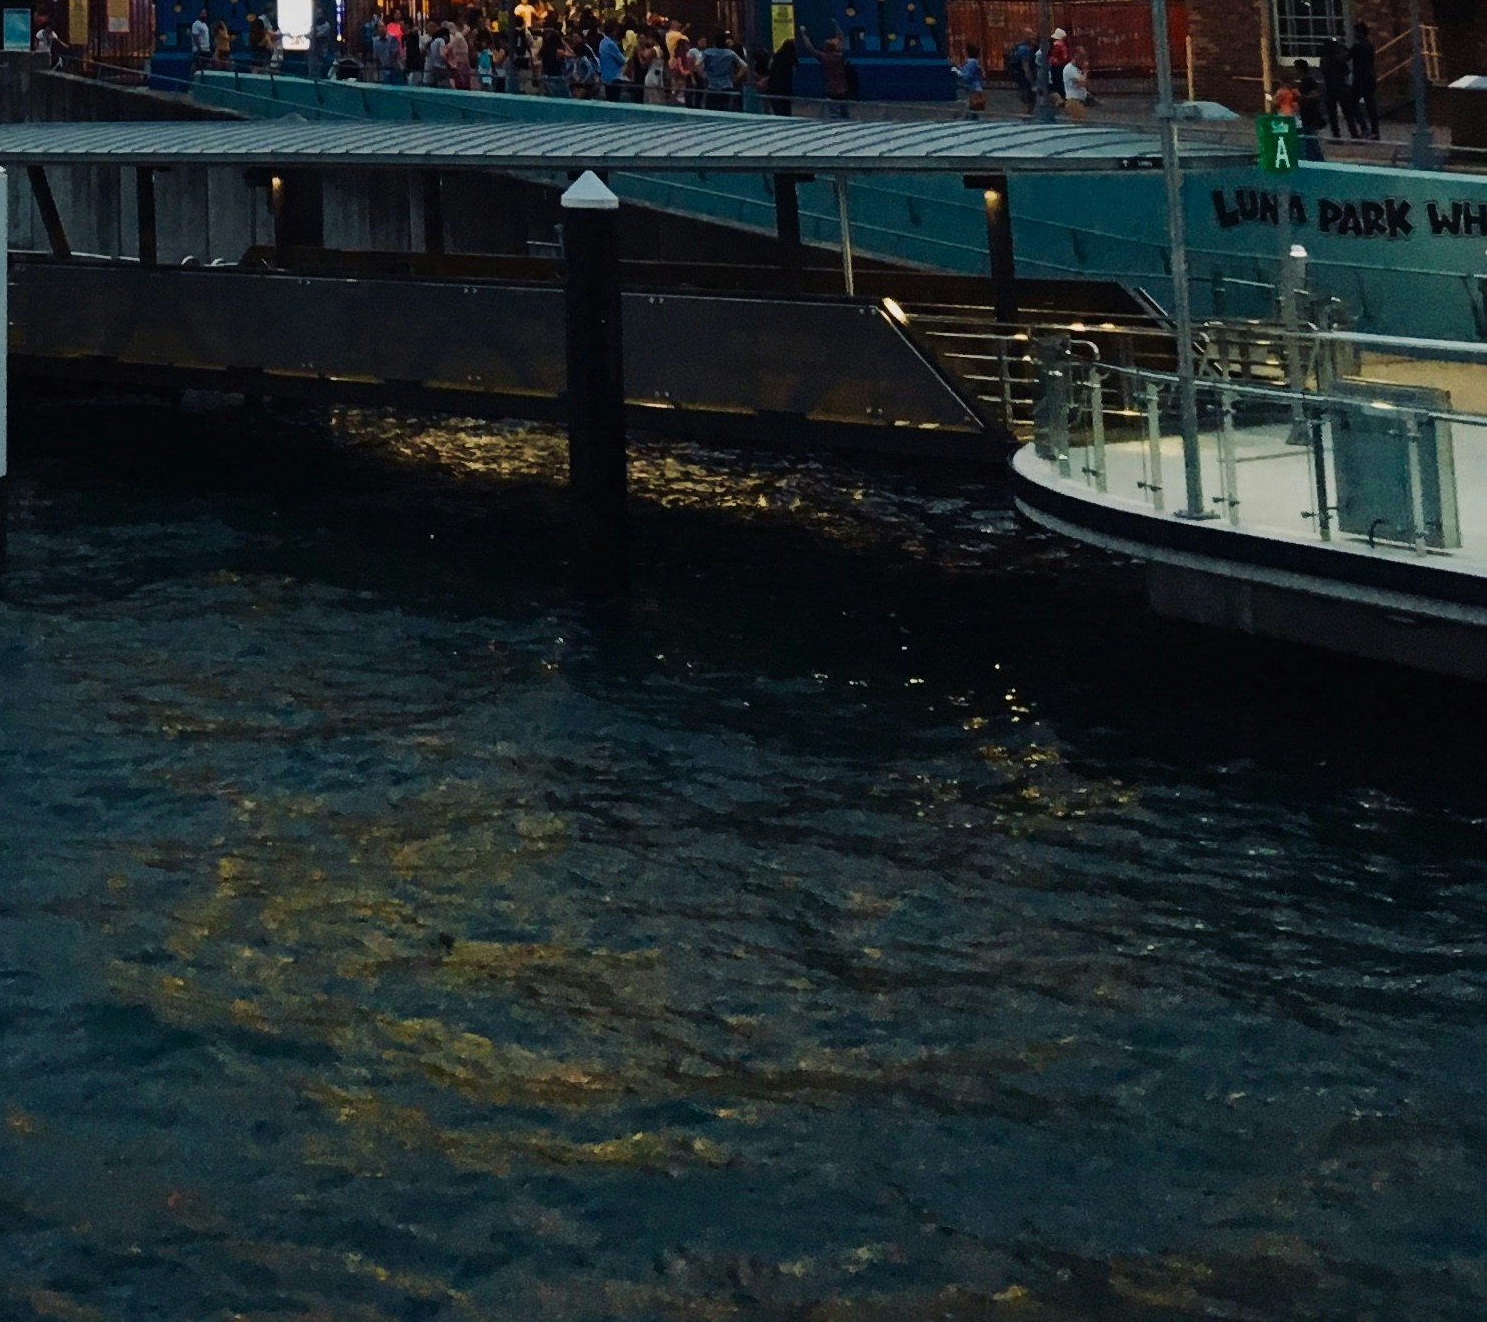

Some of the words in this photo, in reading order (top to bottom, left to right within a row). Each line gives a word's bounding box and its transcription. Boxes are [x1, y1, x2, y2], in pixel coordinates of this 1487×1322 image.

[1275, 136, 1291, 169] A
[1212, 186, 1307, 229] LUNA
[1318, 197, 1414, 239] PARK
[1427, 201, 1487, 237] WH
